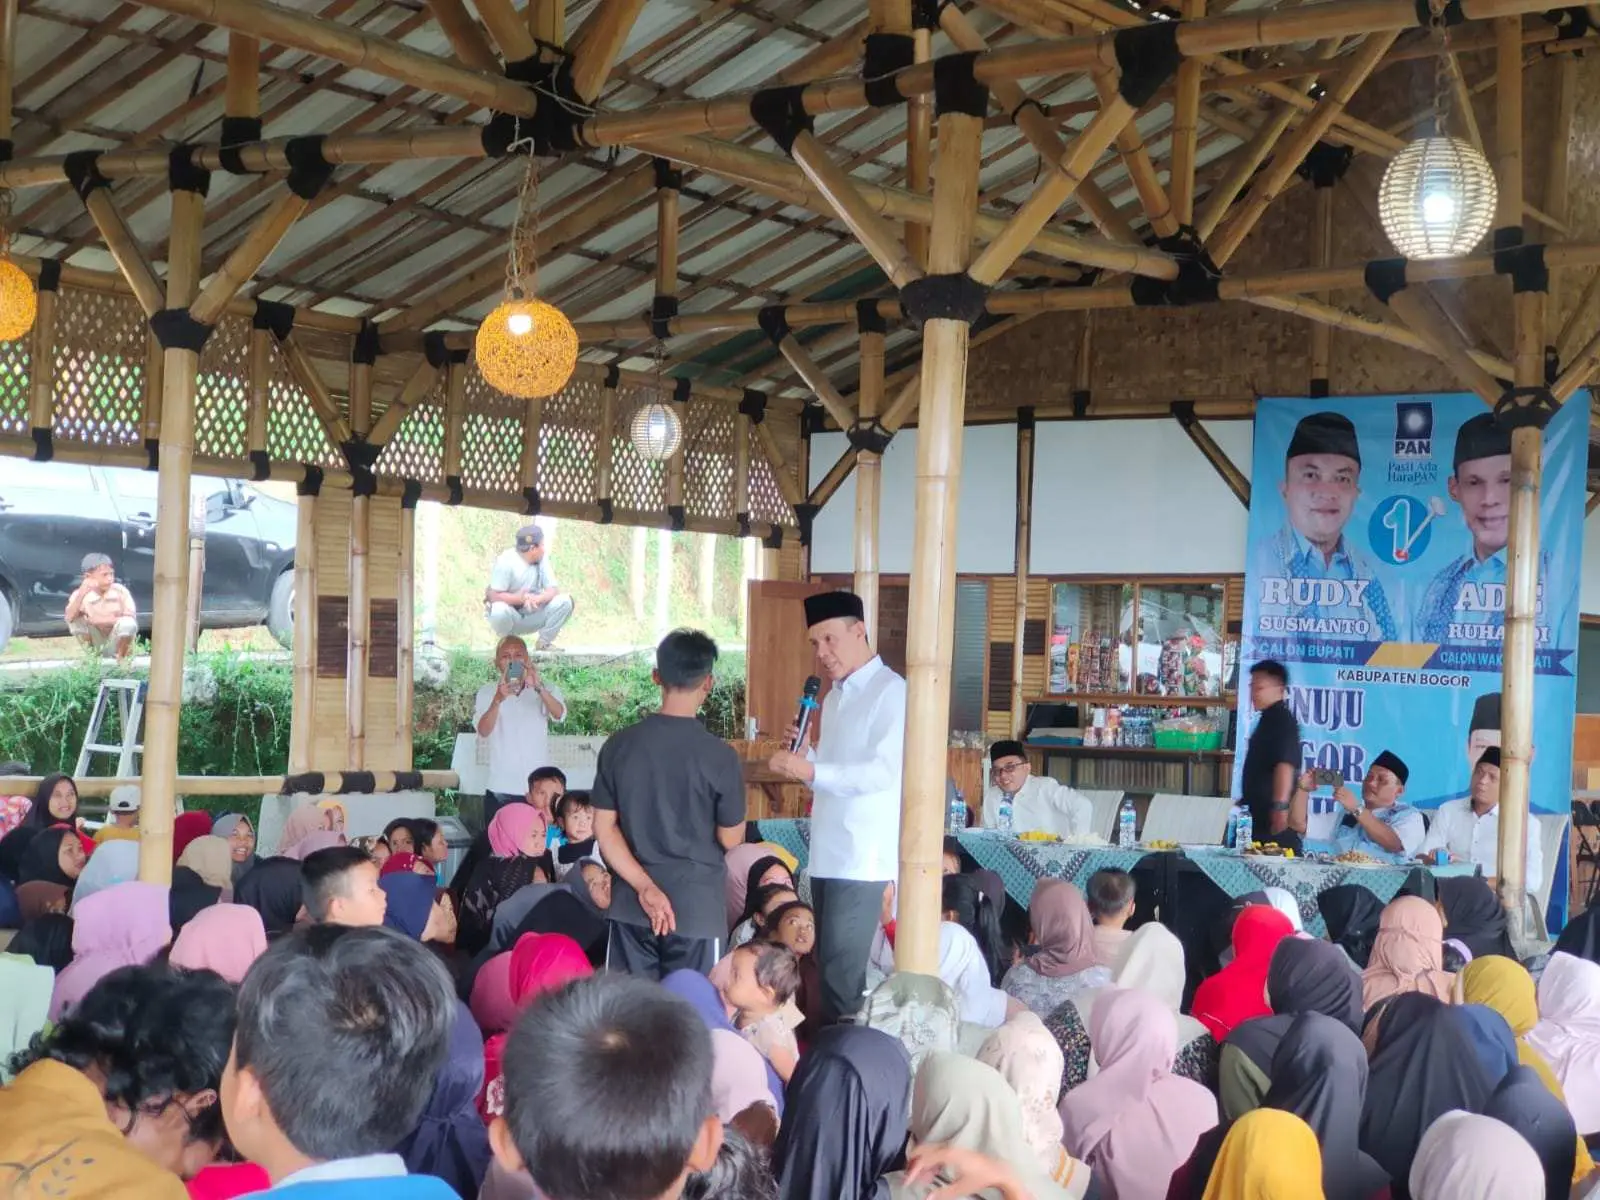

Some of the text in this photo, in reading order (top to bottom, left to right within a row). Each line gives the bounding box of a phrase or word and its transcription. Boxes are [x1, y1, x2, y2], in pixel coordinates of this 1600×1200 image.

[1394, 440, 1431, 455] PAN
[1260, 576, 1370, 608] RUDY
[1453, 581, 1544, 615] AD
[1258, 615, 1371, 636] SUSMANTO
[1447, 622, 1549, 643] RUHAI
[1259, 642, 1355, 659] CALON BUPATI
[1440, 651, 1476, 665] CALON
[1337, 669, 1470, 688] KABUPATEN BOGOR
[1286, 686, 1364, 731] NUJU
